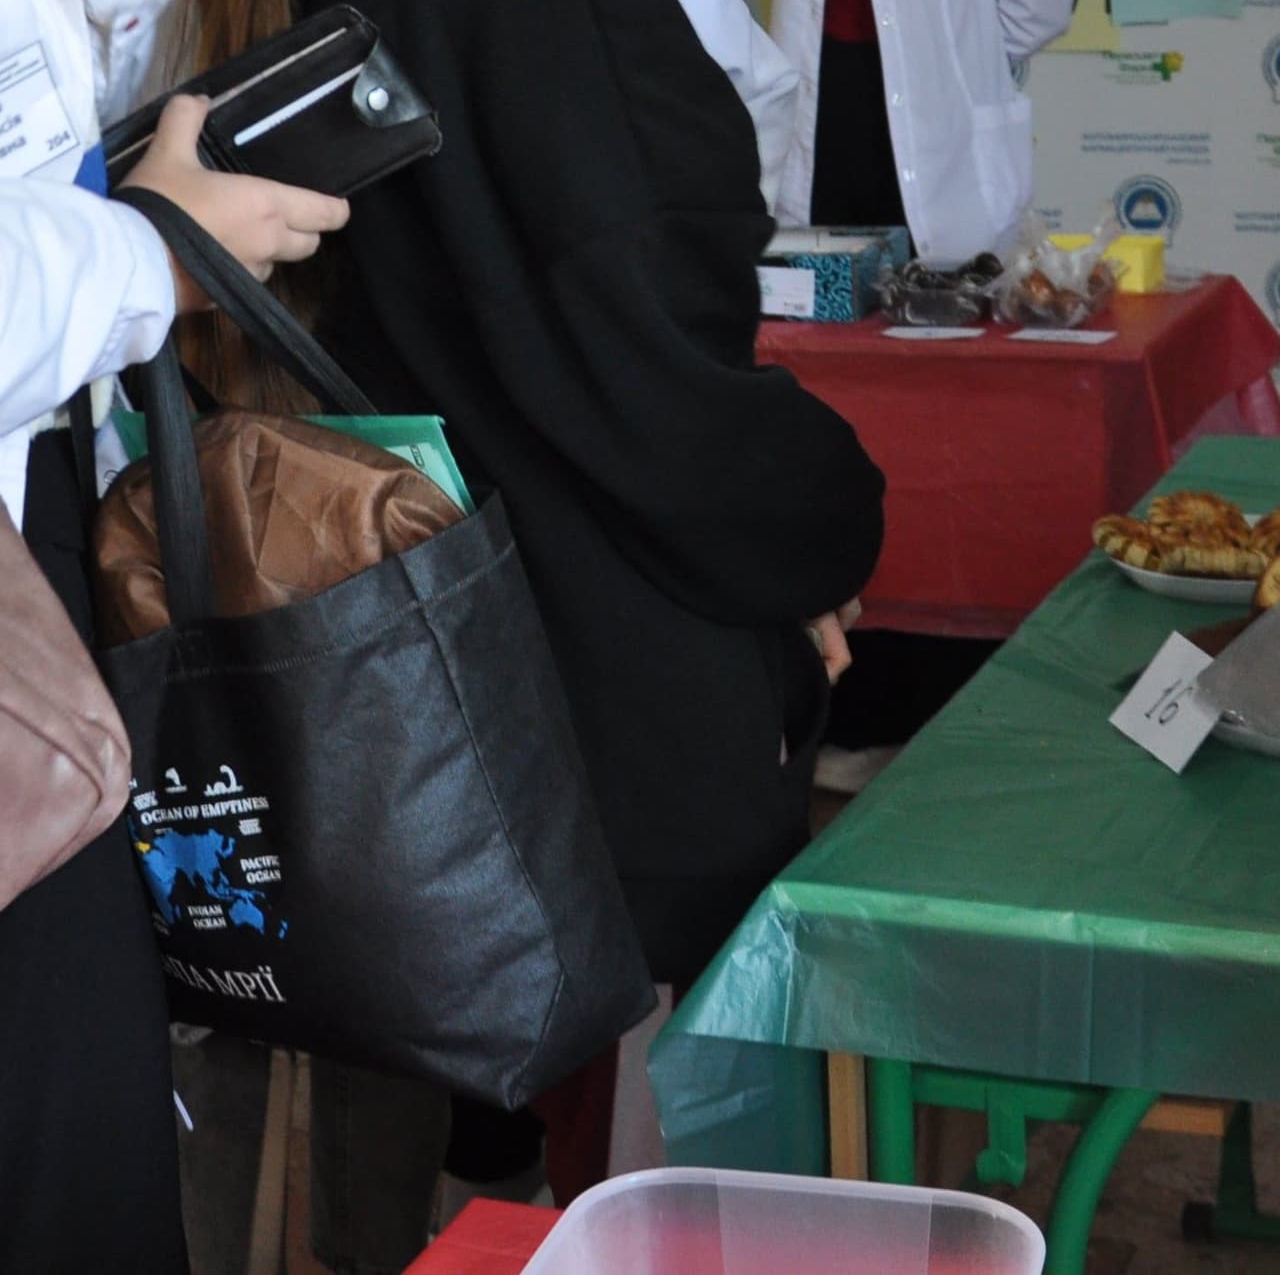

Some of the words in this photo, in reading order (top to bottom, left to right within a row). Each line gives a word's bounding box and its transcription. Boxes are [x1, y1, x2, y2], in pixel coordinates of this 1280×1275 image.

[140, 806, 183, 825] OCEAN
[183, 804, 200, 820] OF
[201, 796, 269, 819] EMPTINESS
[245, 869, 282, 885] OCEAN
[187, 904, 224, 917] INDIAN
[193, 916, 228, 930] OCEAN
[206, 964, 287, 1004] МРІЇ
